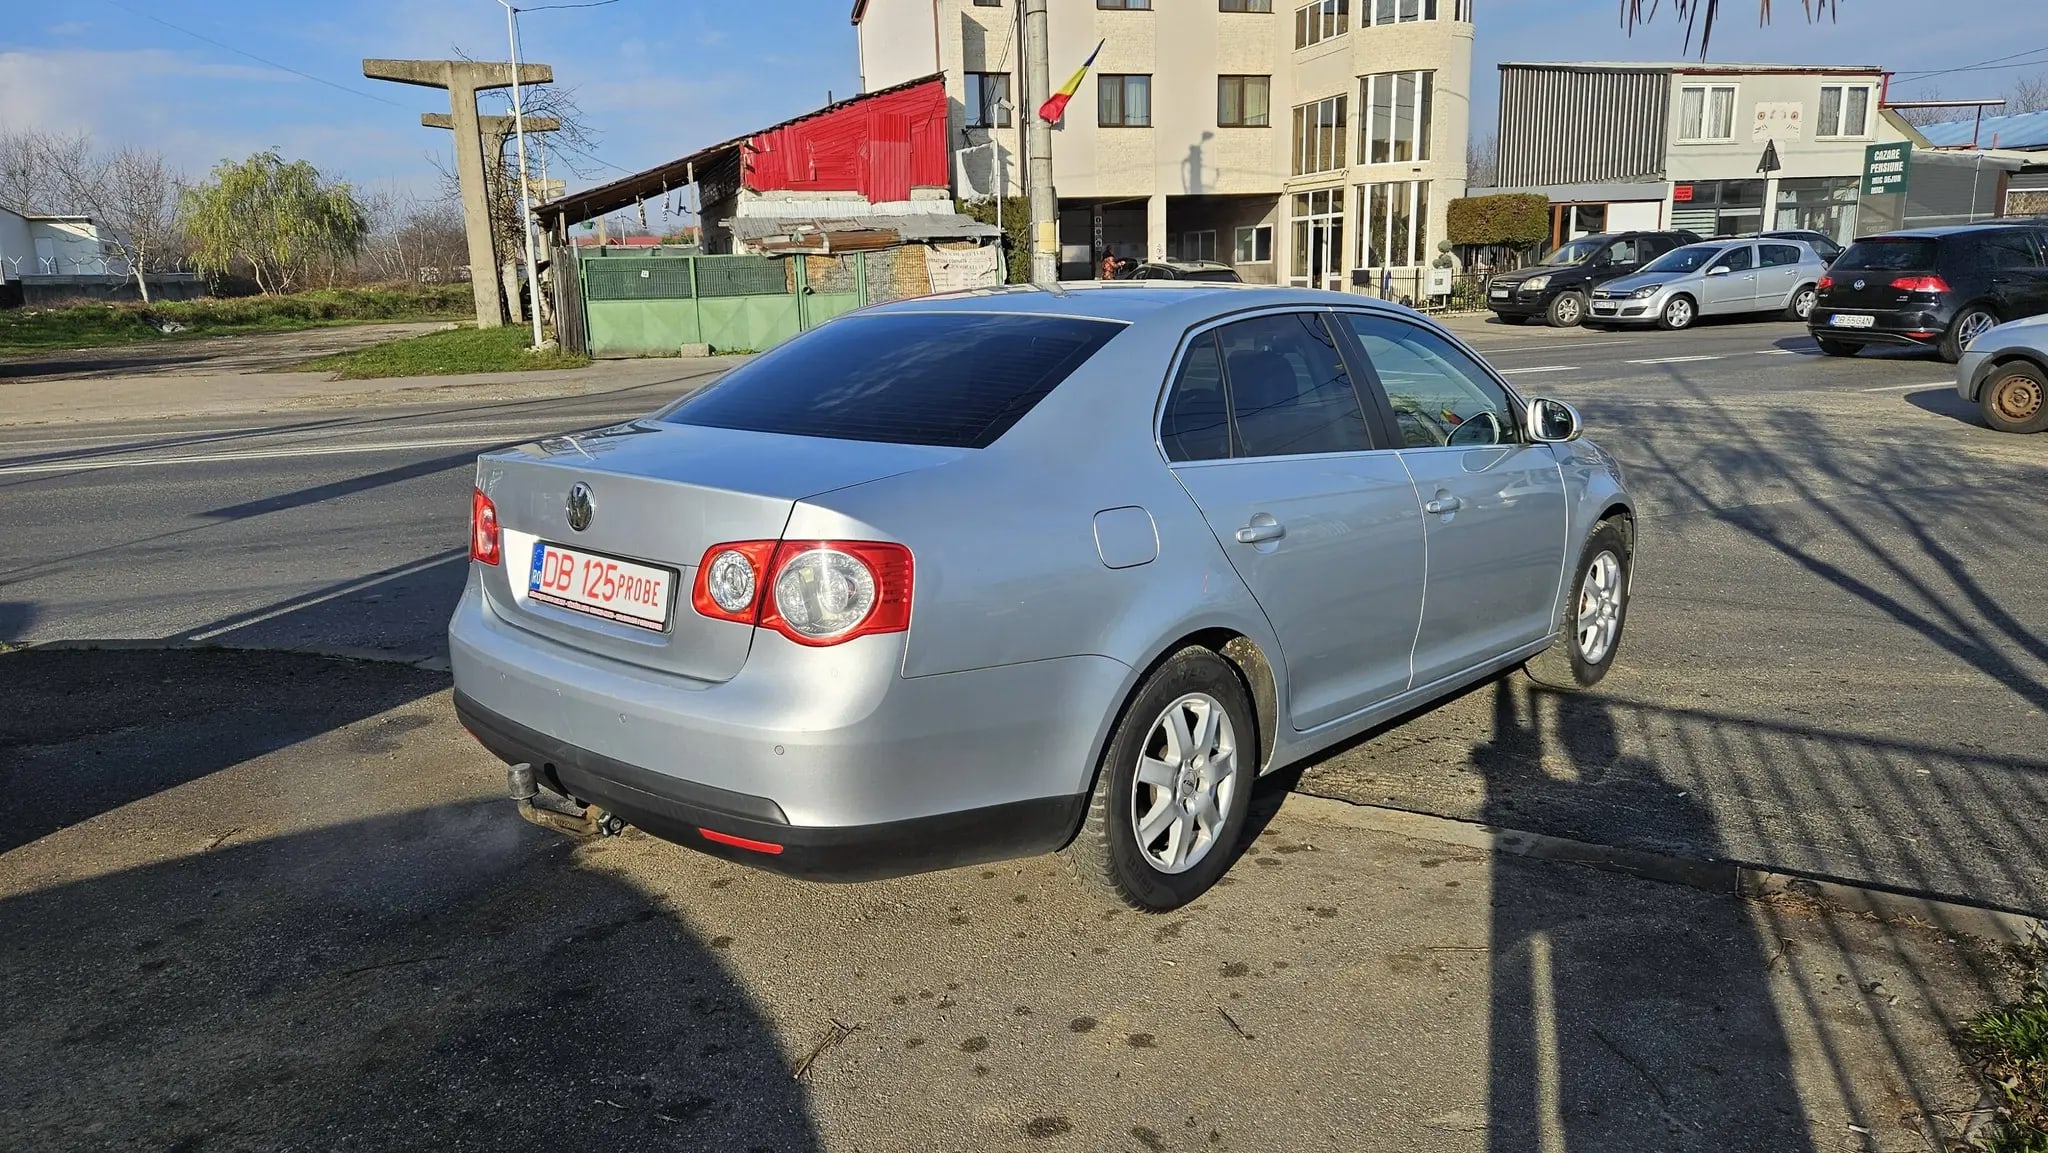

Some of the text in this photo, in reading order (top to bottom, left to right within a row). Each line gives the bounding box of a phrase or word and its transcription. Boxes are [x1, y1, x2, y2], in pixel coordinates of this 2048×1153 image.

[1874, 149, 1901, 161] CAZARE
[1870, 161, 1904, 174] PENSIUNE
[543, 551, 574, 591] DB
[582, 560, 618, 602] 125
[616, 574, 661, 607] PROBE
